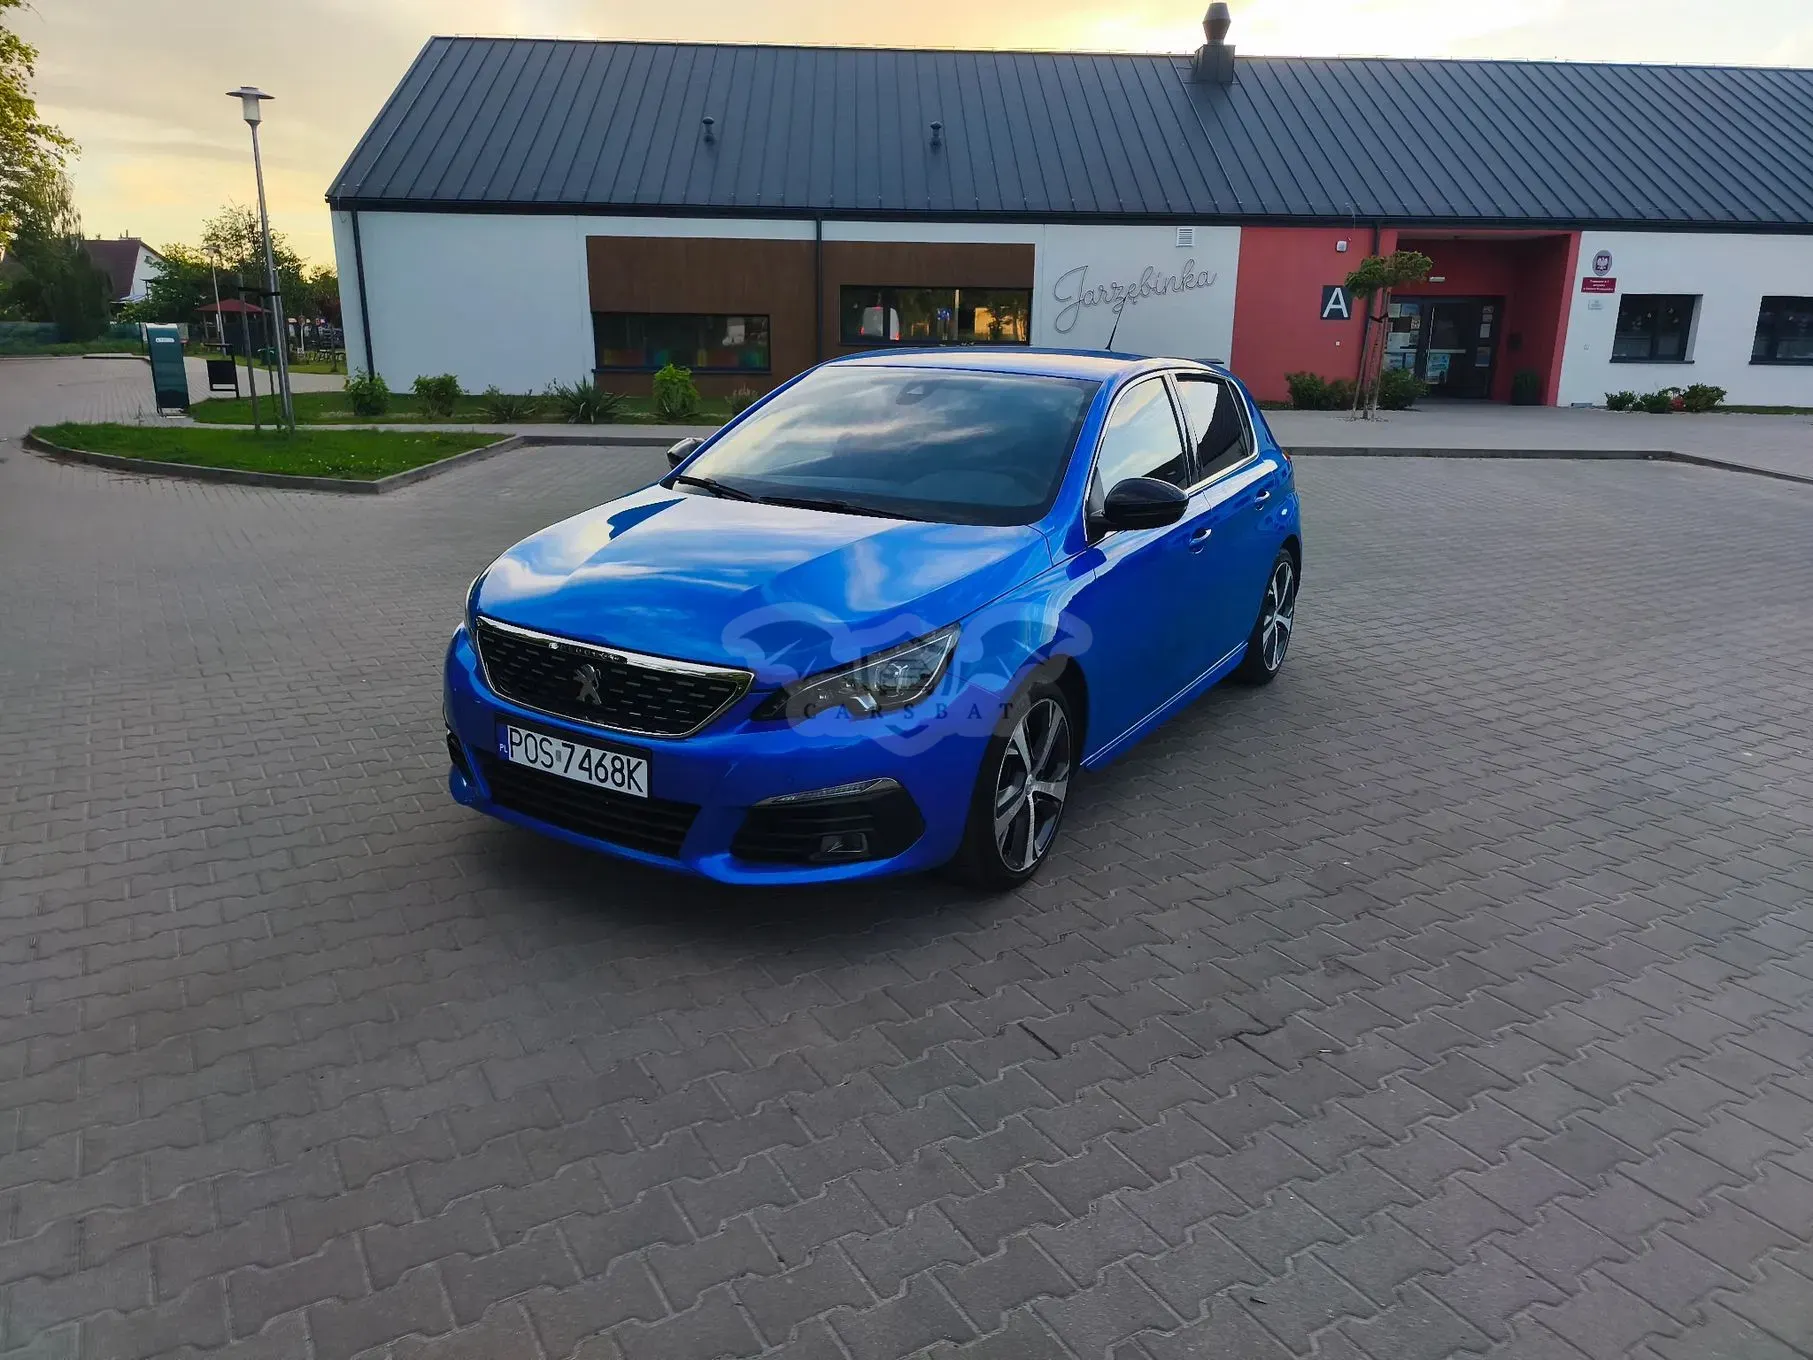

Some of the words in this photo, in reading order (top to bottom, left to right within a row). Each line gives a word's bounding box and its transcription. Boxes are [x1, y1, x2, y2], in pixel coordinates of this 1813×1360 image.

[1053, 258, 1218, 334] Jarzębinka
[1322, 287, 1349, 318] A
[499, 743, 508, 754] PL
[509, 727, 554, 769] POS
[561, 742, 644, 793] 7468K
